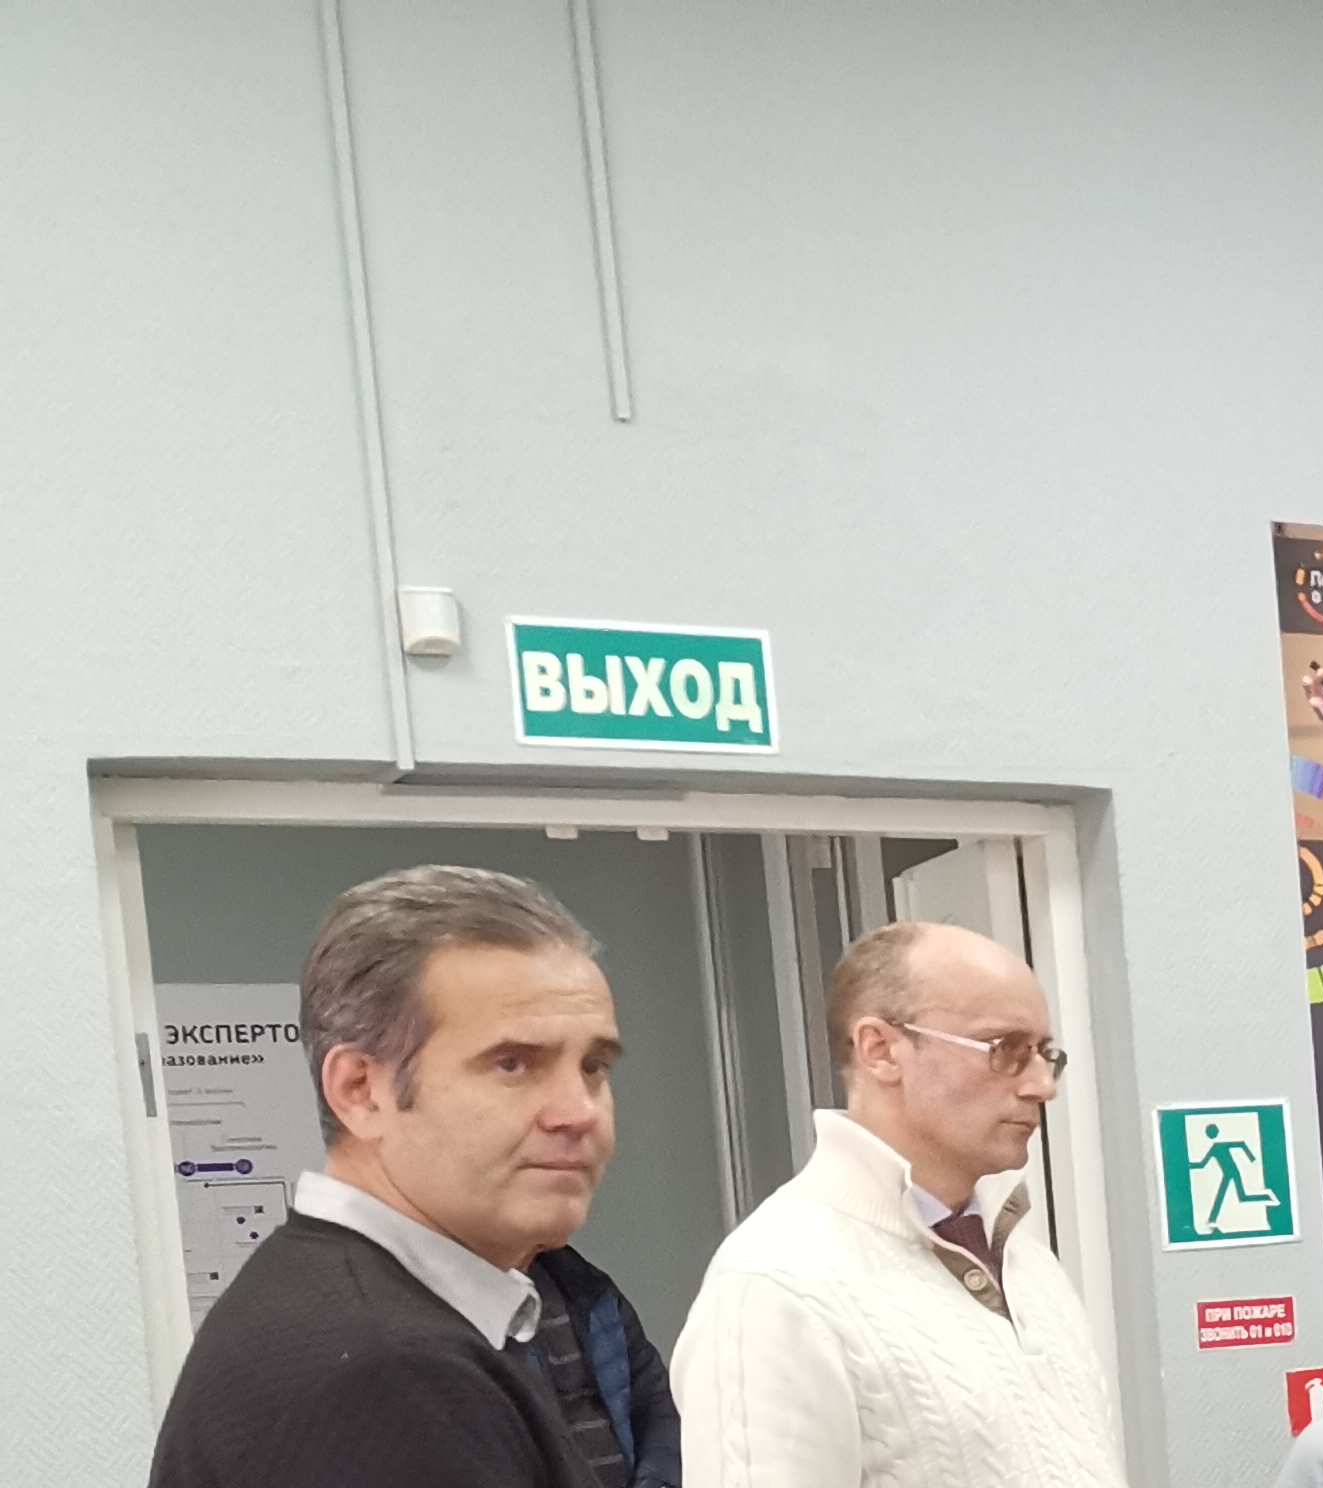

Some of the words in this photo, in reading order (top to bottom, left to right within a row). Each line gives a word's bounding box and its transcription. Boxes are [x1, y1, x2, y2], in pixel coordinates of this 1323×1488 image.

[521, 650, 764, 734] ВЫХОД
[164, 1023, 300, 1045] ЭКСПЕРТО
[1205, 1307, 1232, 1323] ПРИ
[1233, 1303, 1287, 1321] ПОЖАРЕ
